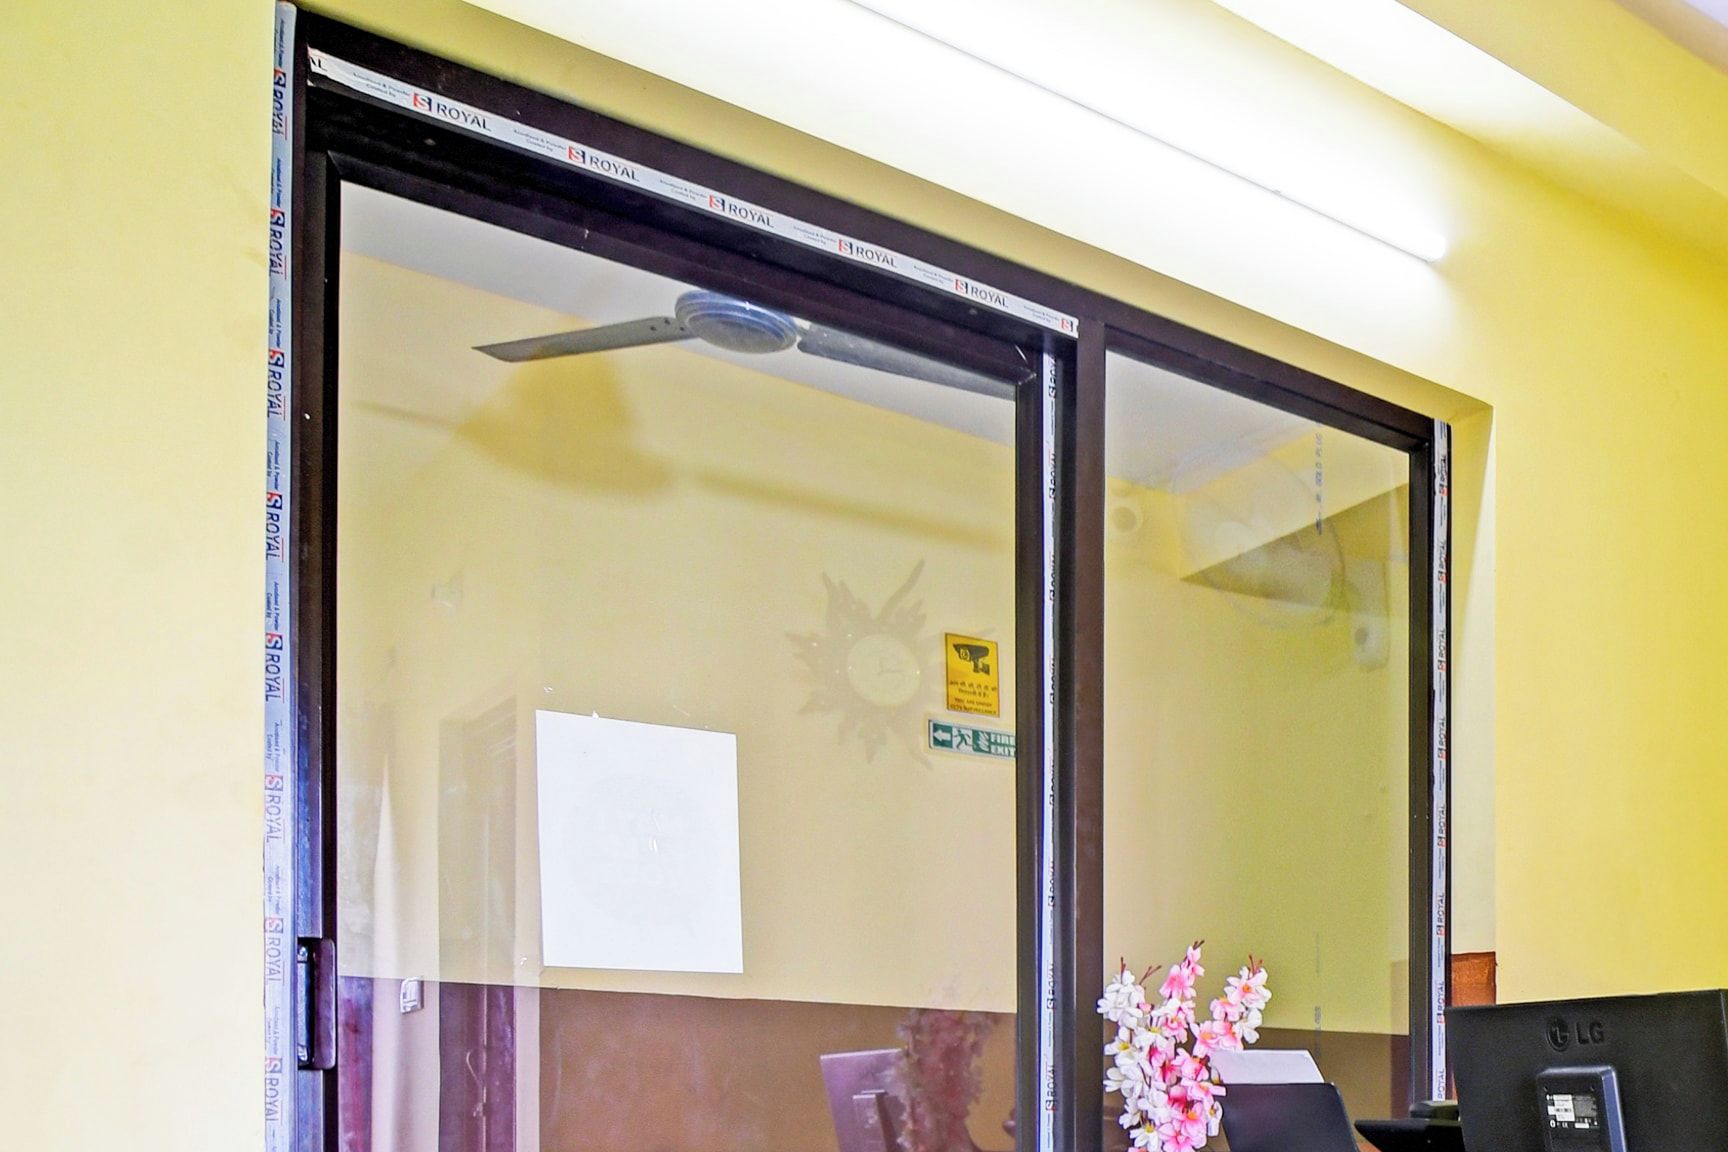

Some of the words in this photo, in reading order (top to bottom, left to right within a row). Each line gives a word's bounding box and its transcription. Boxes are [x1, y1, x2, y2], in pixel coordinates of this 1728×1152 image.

[437, 101, 492, 132] ROYAL
[589, 156, 640, 183] ROYAL
[728, 204, 775, 229] ROYAL
[856, 246, 898, 269] ROYAL
[970, 286, 1009, 308] ROYAL
[267, 369, 282, 418] ROYAL
[266, 511, 280, 561] ROYAL
[265, 652, 281, 702] ROYAL
[265, 795, 282, 843] ROYAL
[1438, 803, 1446, 835] ROYAL
[1437, 892, 1445, 923] ROYAL
[266, 937, 281, 986] ROYAL
[1437, 981, 1445, 1011] ROYAL
[1575, 1022, 1604, 1045] LG
[1437, 1068, 1445, 1099] ROYAL
